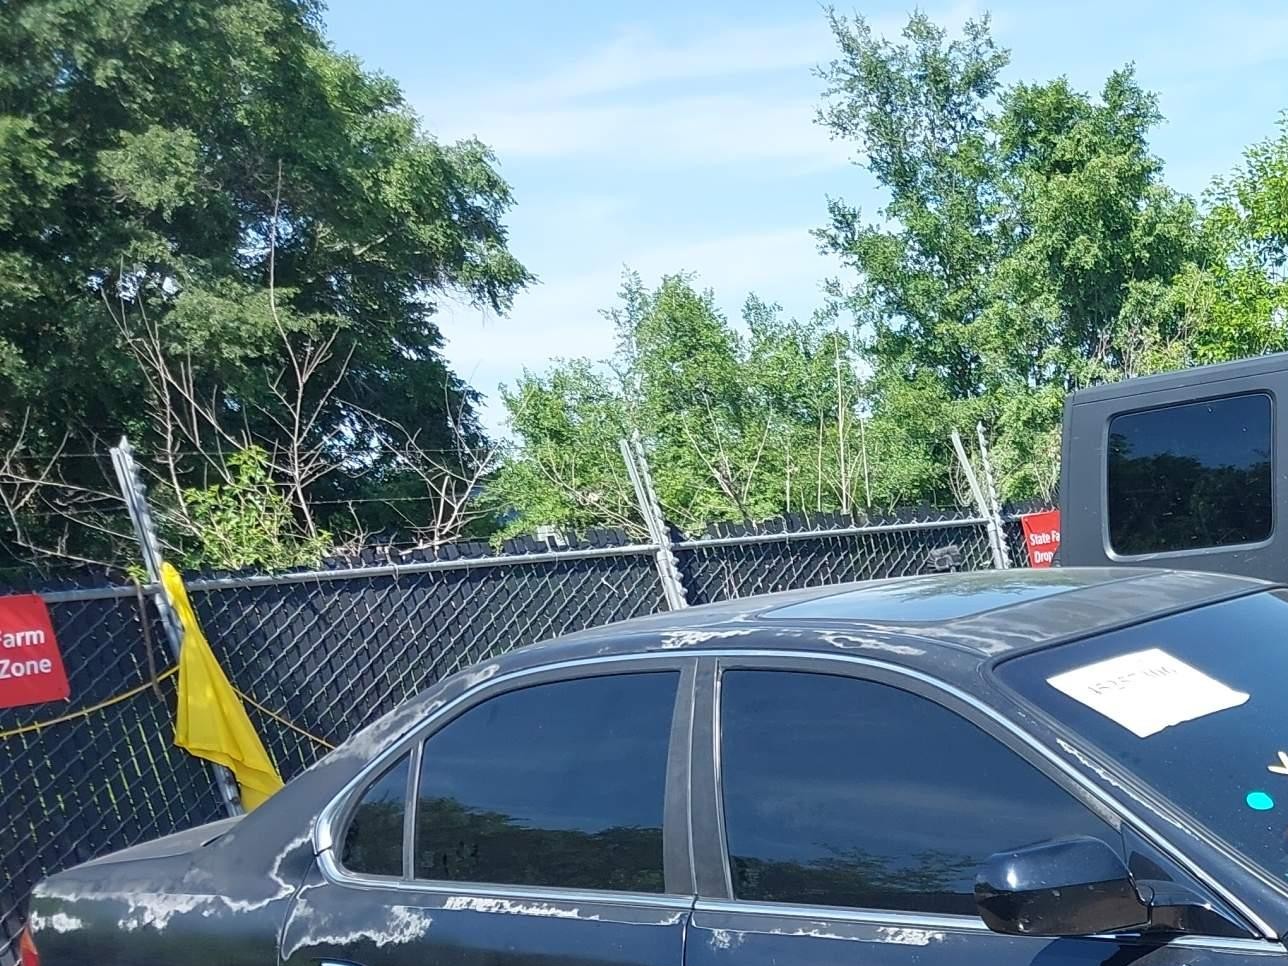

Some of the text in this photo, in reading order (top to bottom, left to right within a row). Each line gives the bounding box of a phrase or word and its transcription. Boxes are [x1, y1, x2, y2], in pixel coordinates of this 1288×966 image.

[1030, 530, 1060, 546] State Fa
[0, 658, 52, 679] Zone
